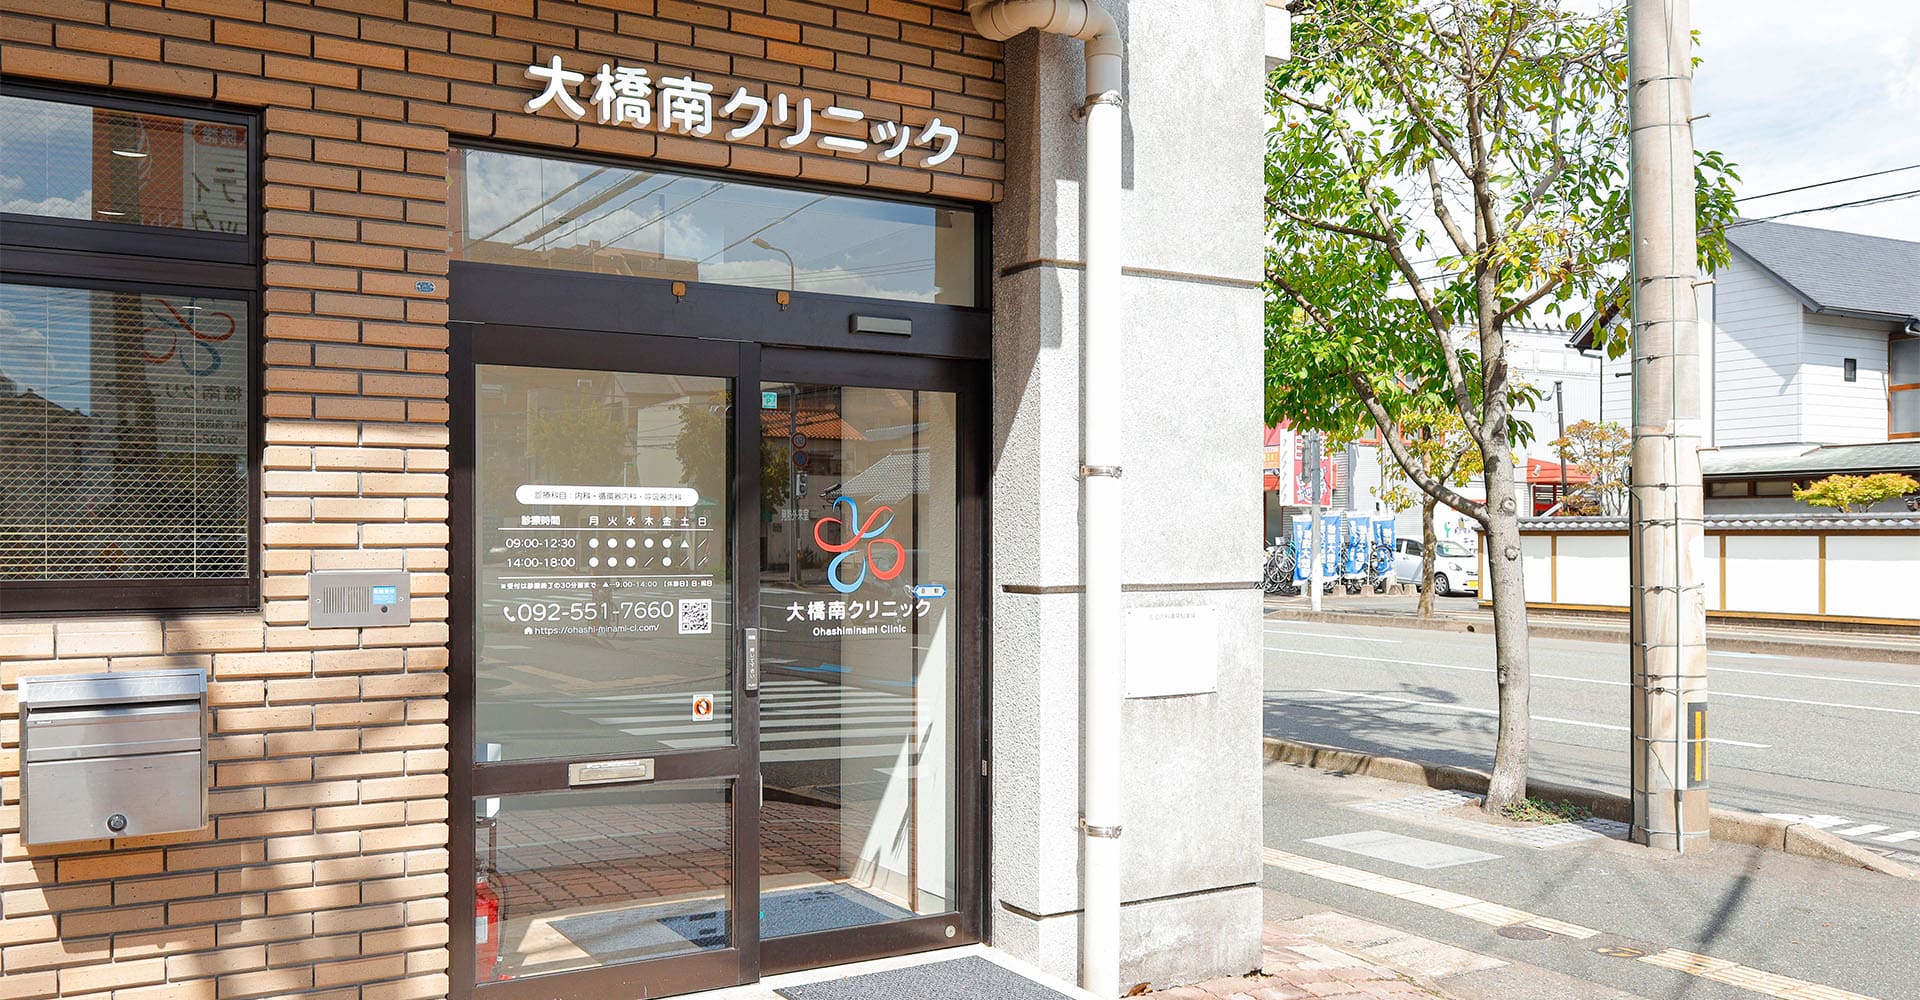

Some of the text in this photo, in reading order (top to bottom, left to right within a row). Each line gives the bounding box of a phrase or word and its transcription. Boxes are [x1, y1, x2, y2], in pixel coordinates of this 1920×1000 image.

[523, 54, 960, 168] 大橋南クリニック
[588, 516, 599, 527] 月
[607, 516, 618, 527] 火
[626, 516, 637, 527] 水
[644, 516, 654, 527] 木
[662, 516, 672, 527] 金
[680, 516, 690, 527] 土
[698, 516, 707, 527] 日
[505, 538, 575, 549] 09:00-12:30
[506, 558, 575, 568] 14:00-18:00
[517, 601, 674, 622] 092-551-7660
[785, 598, 932, 623] 大橋南クリニック
[812, 624, 907, 637] Ohashiminami Clinic
